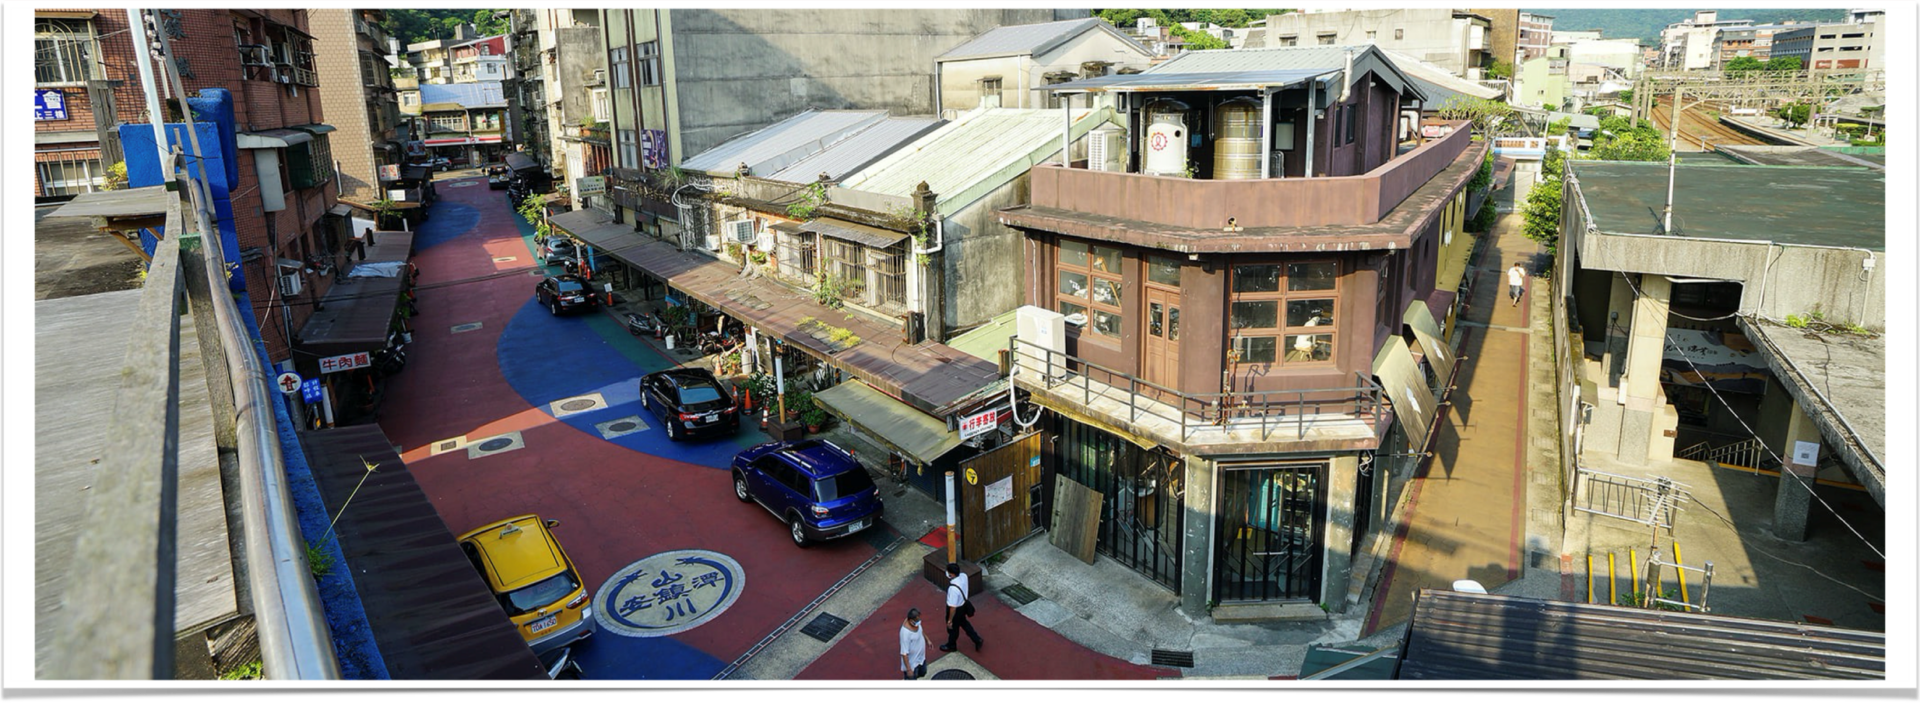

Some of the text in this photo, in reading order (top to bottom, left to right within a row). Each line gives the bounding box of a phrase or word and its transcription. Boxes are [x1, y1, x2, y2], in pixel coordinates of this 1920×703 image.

[322, 353, 368, 371] 牛肉麵
[651, 569, 683, 588] 山
[665, 598, 697, 622] 川
